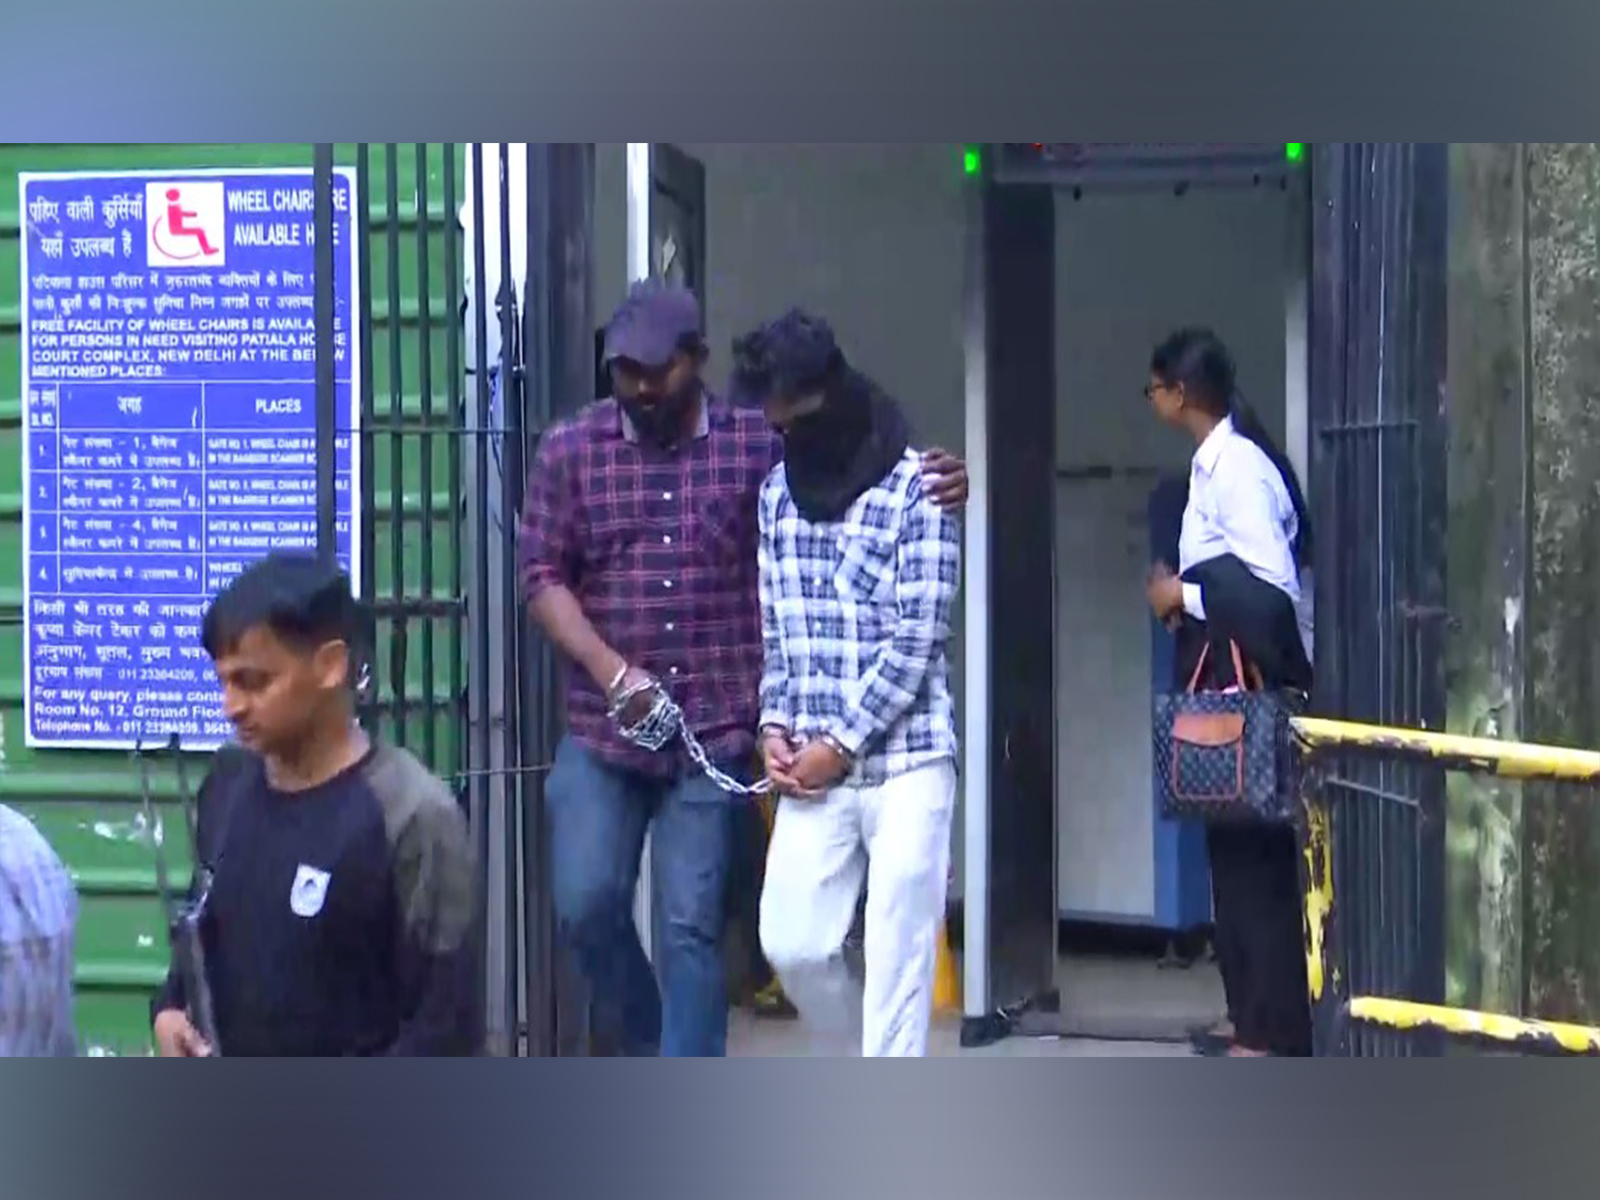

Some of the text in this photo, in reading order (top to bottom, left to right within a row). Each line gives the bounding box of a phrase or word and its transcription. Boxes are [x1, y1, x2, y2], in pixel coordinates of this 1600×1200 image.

[66, 195, 94, 221] वाली
[227, 189, 271, 212] WHEEL
[233, 221, 339, 247] AVAILABLE HE
[71, 237, 115, 258] उपलब्ध
[32, 316, 341, 332] FREE FACILITY OF WHEEL CHAIRS IS AVAILAE
[32, 332, 346, 347] FOR PERSONS IN NEED VISITING PATIALA HOE
[32, 350, 79, 363] COURT
[158, 350, 190, 362] NEW
[194, 349, 236, 362] DELHI
[240, 349, 256, 361] AT
[261, 349, 290, 361] THE
[292, 348, 345, 361] BEW
[32, 365, 107, 378] MENTIONED
[255, 398, 302, 414] PLACES
[34, 686, 57, 700] For
[61, 689, 85, 704] any
[137, 687, 183, 703] please
[34, 702, 75, 717] Room
[133, 704, 188, 718] Ground
[192, 704, 222, 718] Floo
[34, 719, 91, 734] Telephone
